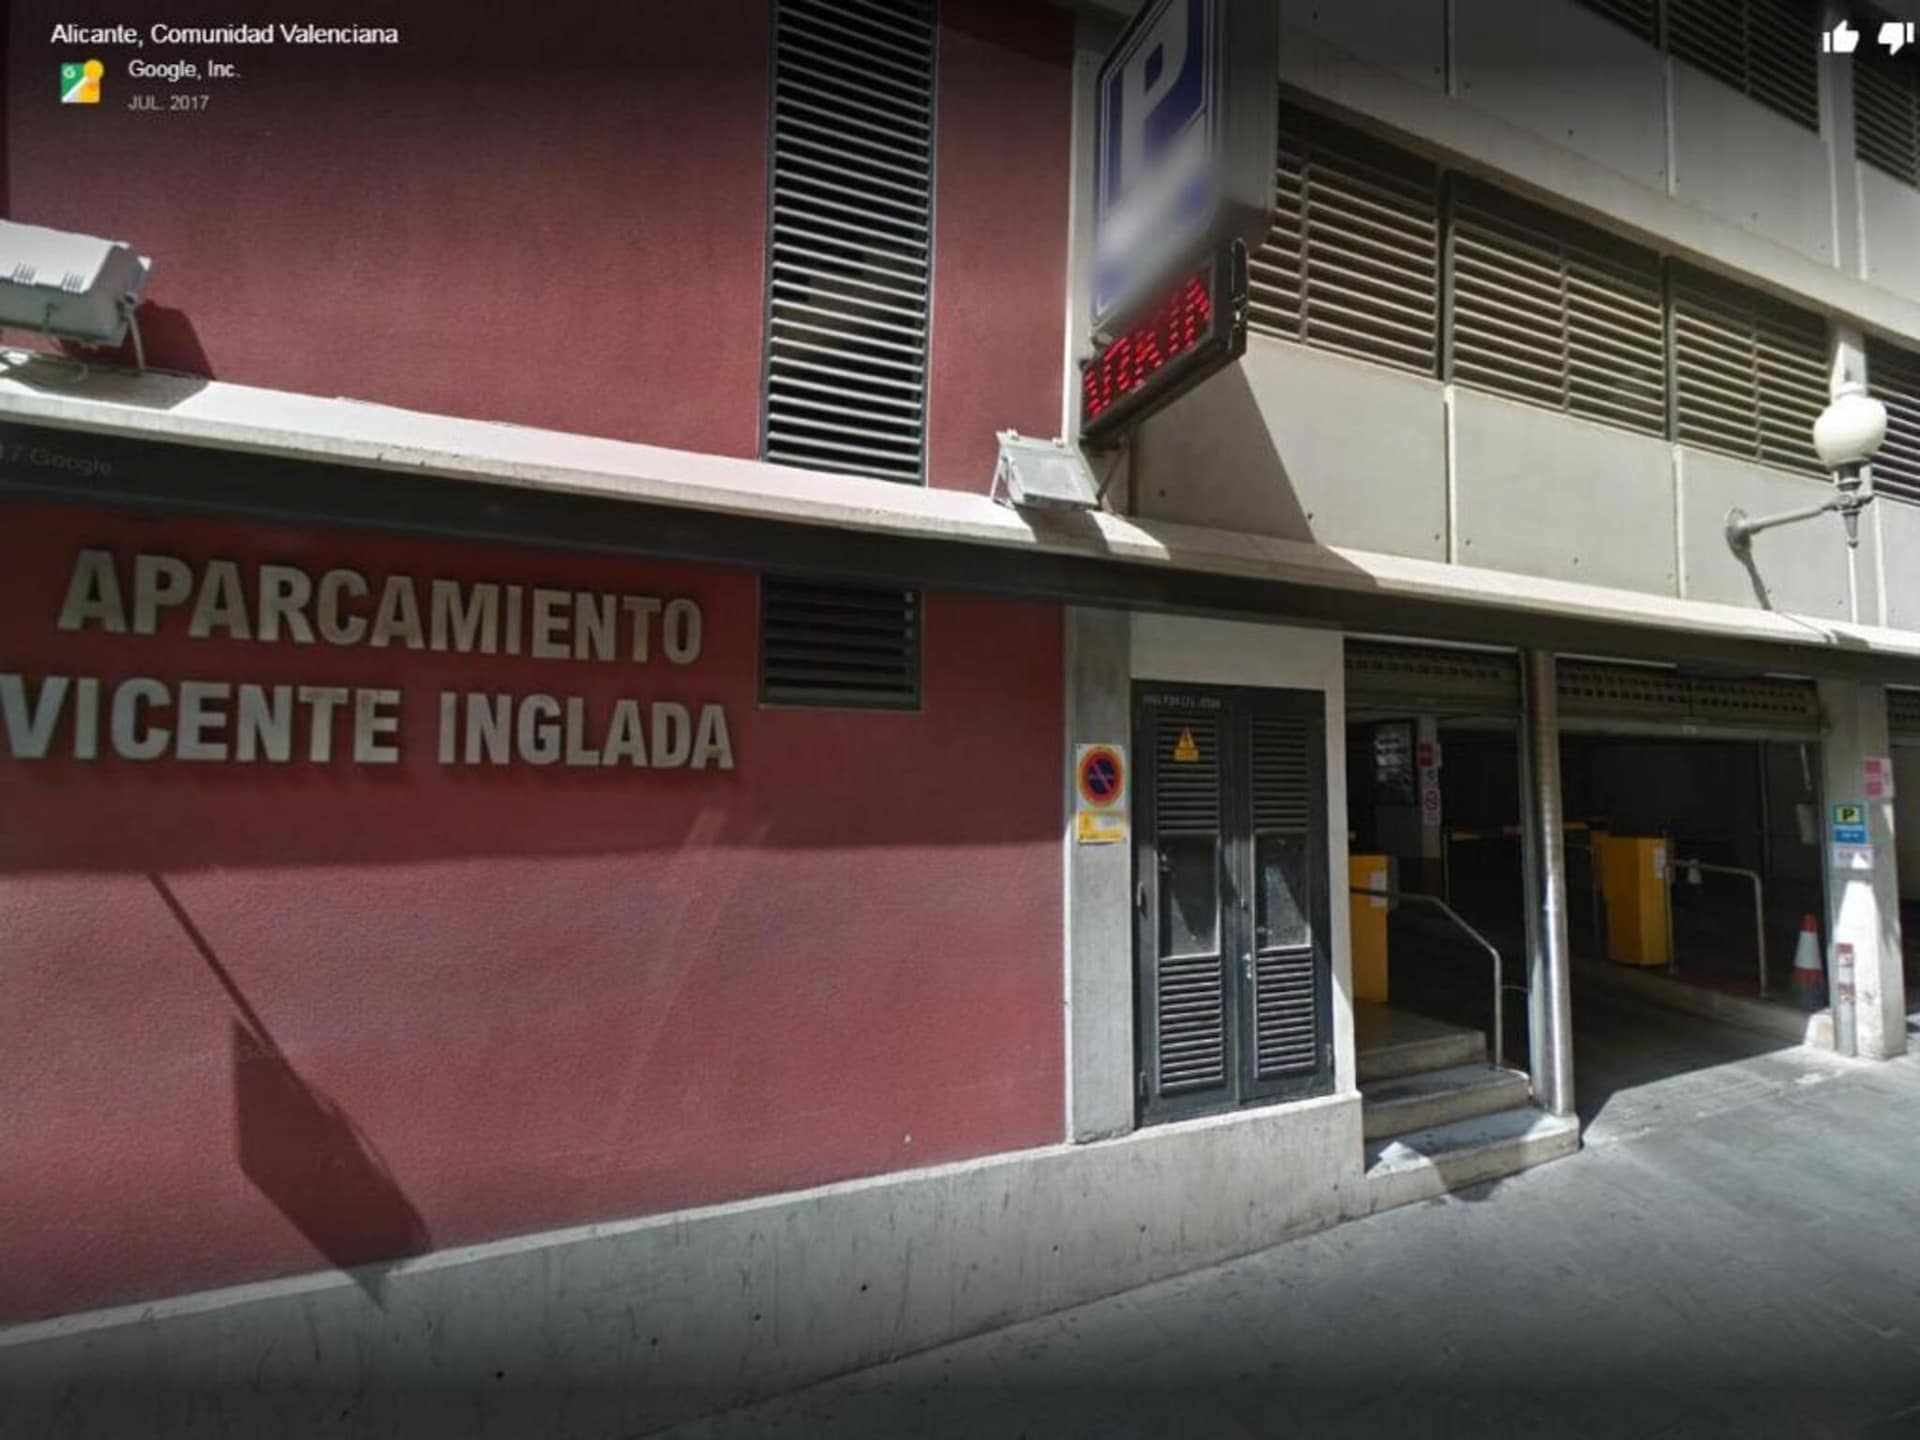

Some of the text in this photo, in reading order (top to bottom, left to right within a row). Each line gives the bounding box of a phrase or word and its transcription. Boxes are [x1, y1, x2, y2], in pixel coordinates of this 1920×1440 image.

[57, 548, 704, 666] APARCAMIENTO
[0, 674, 736, 771] VICENTE INGLADA
[1842, 807, 1856, 821] P
